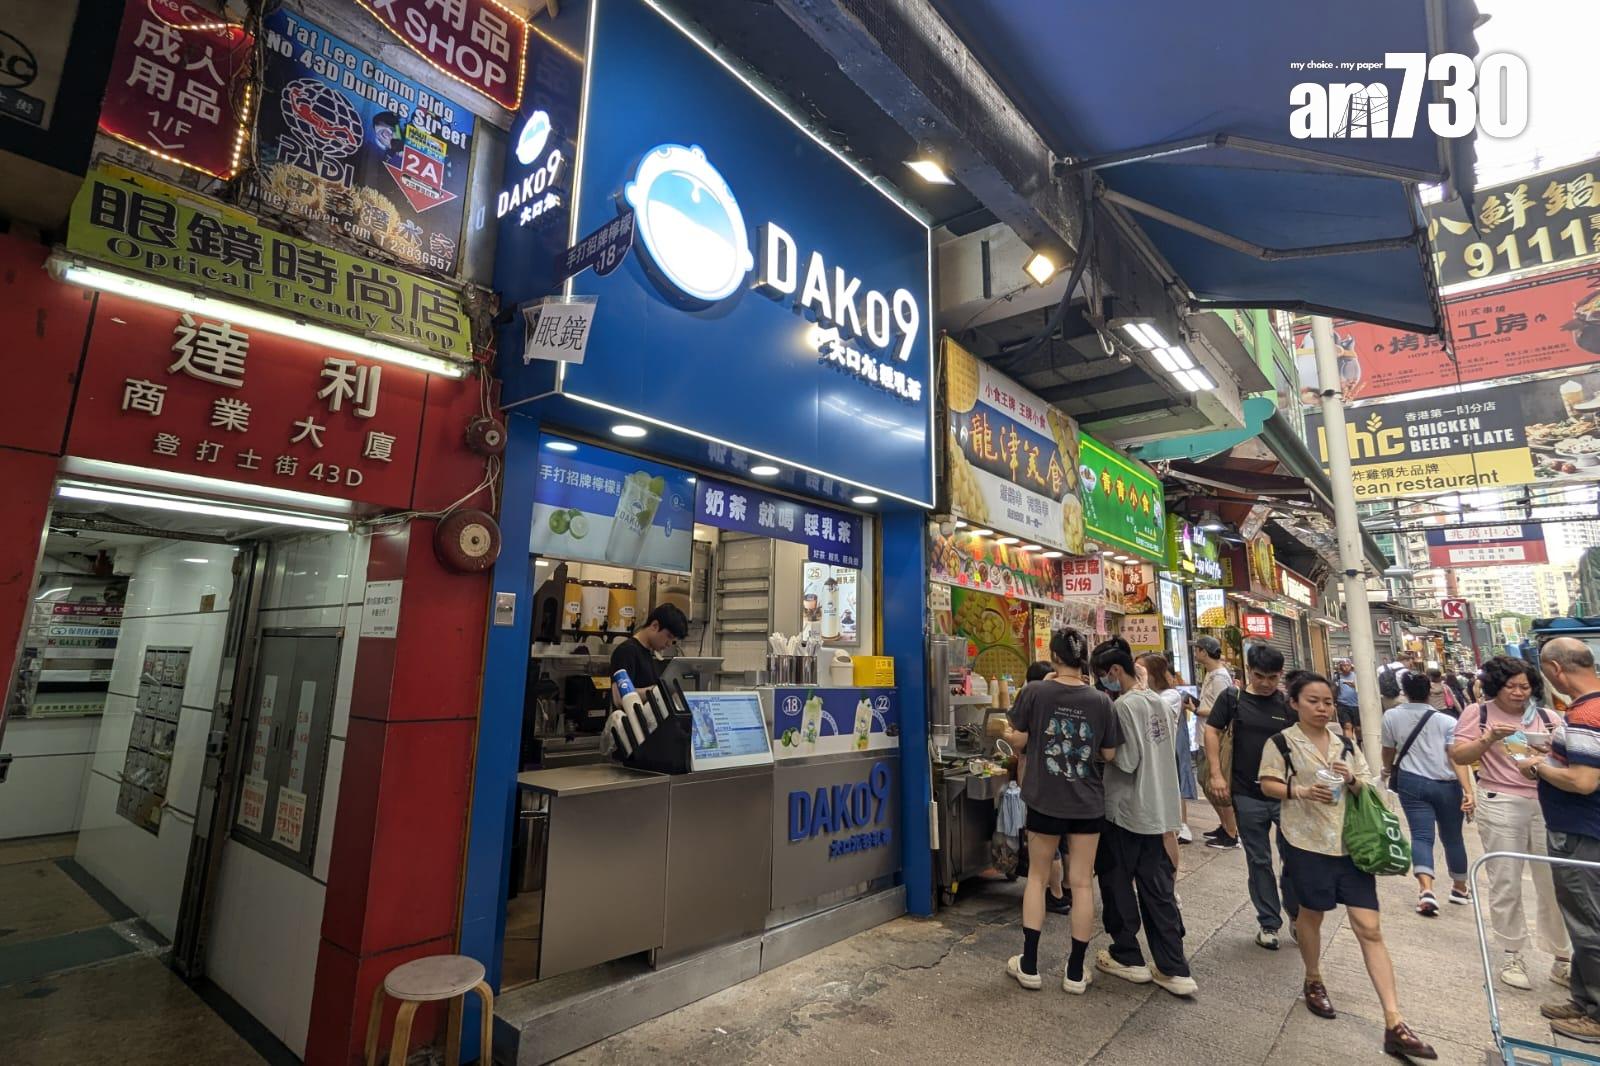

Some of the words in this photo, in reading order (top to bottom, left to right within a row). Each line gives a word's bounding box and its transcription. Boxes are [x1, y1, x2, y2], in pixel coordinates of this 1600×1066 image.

[133, 19, 226, 86] 成人
[286, 16, 318, 49] Tat
[322, 37, 356, 70] Lee
[361, 60, 415, 101] Comm
[404, 7, 508, 88] SHOP
[126, 55, 221, 125] 用品
[342, 70, 409, 119] Dundas
[411, 109, 466, 150] Street
[148, 111, 192, 137] 1/F
[278, 134, 354, 187] PADI
[406, 154, 438, 184] 2A
[90, 181, 462, 335] 眼鏡時尚店
[107, 237, 254, 291] Optical
[266, 279, 382, 329] Trendy
[391, 313, 455, 353] Shop
[534, 315, 588, 351] 眼鏡
[167, 313, 382, 419] 達利
[121, 377, 397, 462] 商業大廈
[1408, 417, 1480, 438] CHICKEN
[153, 432, 299, 476] 登打士街
[309, 462, 363, 487] 43D
[1396, 469, 1500, 493] restaurant
[705, 488, 747, 521] 奶茶
[1063, 559, 1099, 575] 臭豆腐
